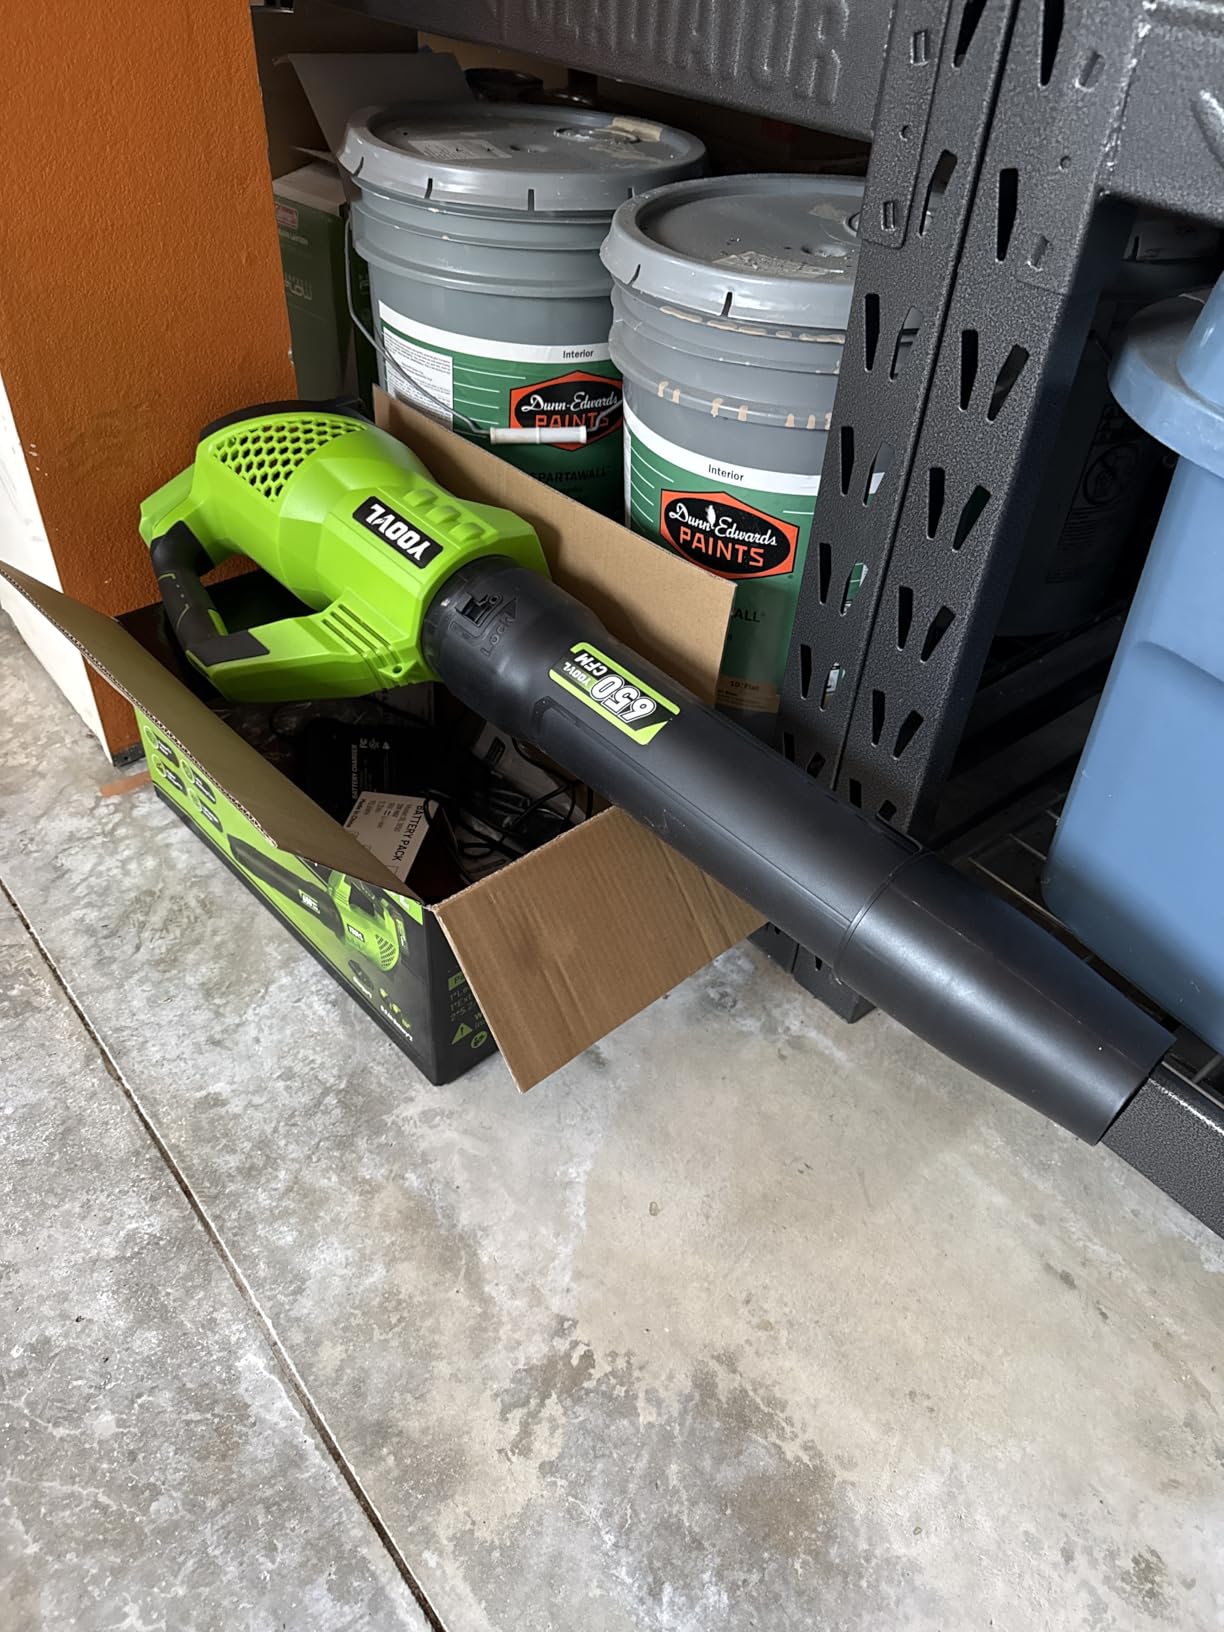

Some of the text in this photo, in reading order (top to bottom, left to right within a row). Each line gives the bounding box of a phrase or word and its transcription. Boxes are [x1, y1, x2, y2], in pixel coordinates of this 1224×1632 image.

[562, 350, 594, 359] Interior
[521, 391, 618, 413] Dunn-Edwards
[708, 464, 744, 481] Interior
[365, 503, 431, 561] YOOVL
[668, 502, 777, 546] Dunn-Edwards
[679, 526, 765, 567] PAINTS
[562, 661, 591, 686] YOOVL
[573, 652, 657, 723] 650 CFM
[391, 805, 424, 861] BATTERY PACK
